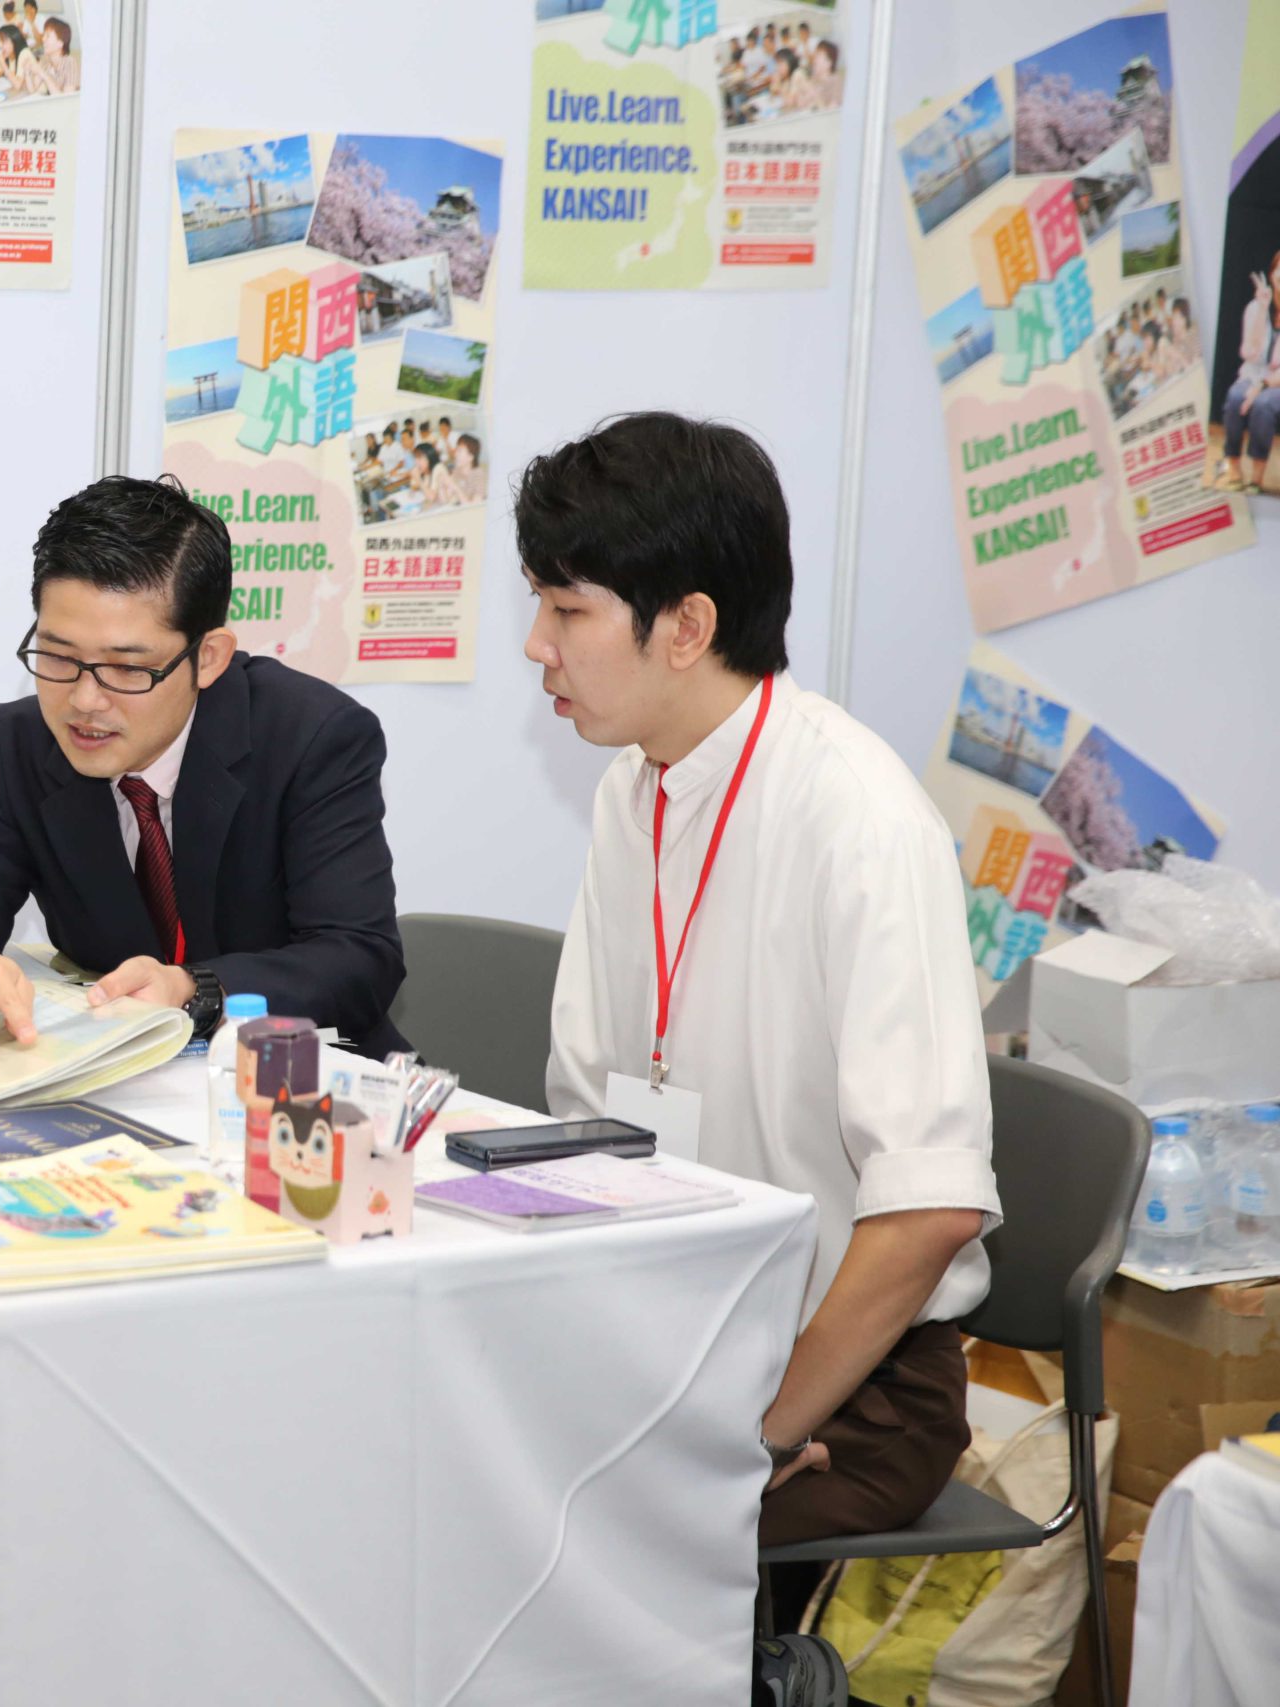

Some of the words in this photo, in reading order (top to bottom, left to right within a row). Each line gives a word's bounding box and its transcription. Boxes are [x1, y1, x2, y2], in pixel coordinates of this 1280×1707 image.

[546, 88, 685, 125] Live.Learn.
[543, 137, 699, 176] Experience.
[541, 187, 648, 222] KANSAI!
[249, 264, 362, 370] 関西
[961, 406, 1088, 473] Live.Learn.
[967, 450, 1105, 519] Experience.
[972, 503, 1071, 567] KANSAI!
[230, 537, 335, 573] erience.
[228, 586, 284, 622] SAI!
